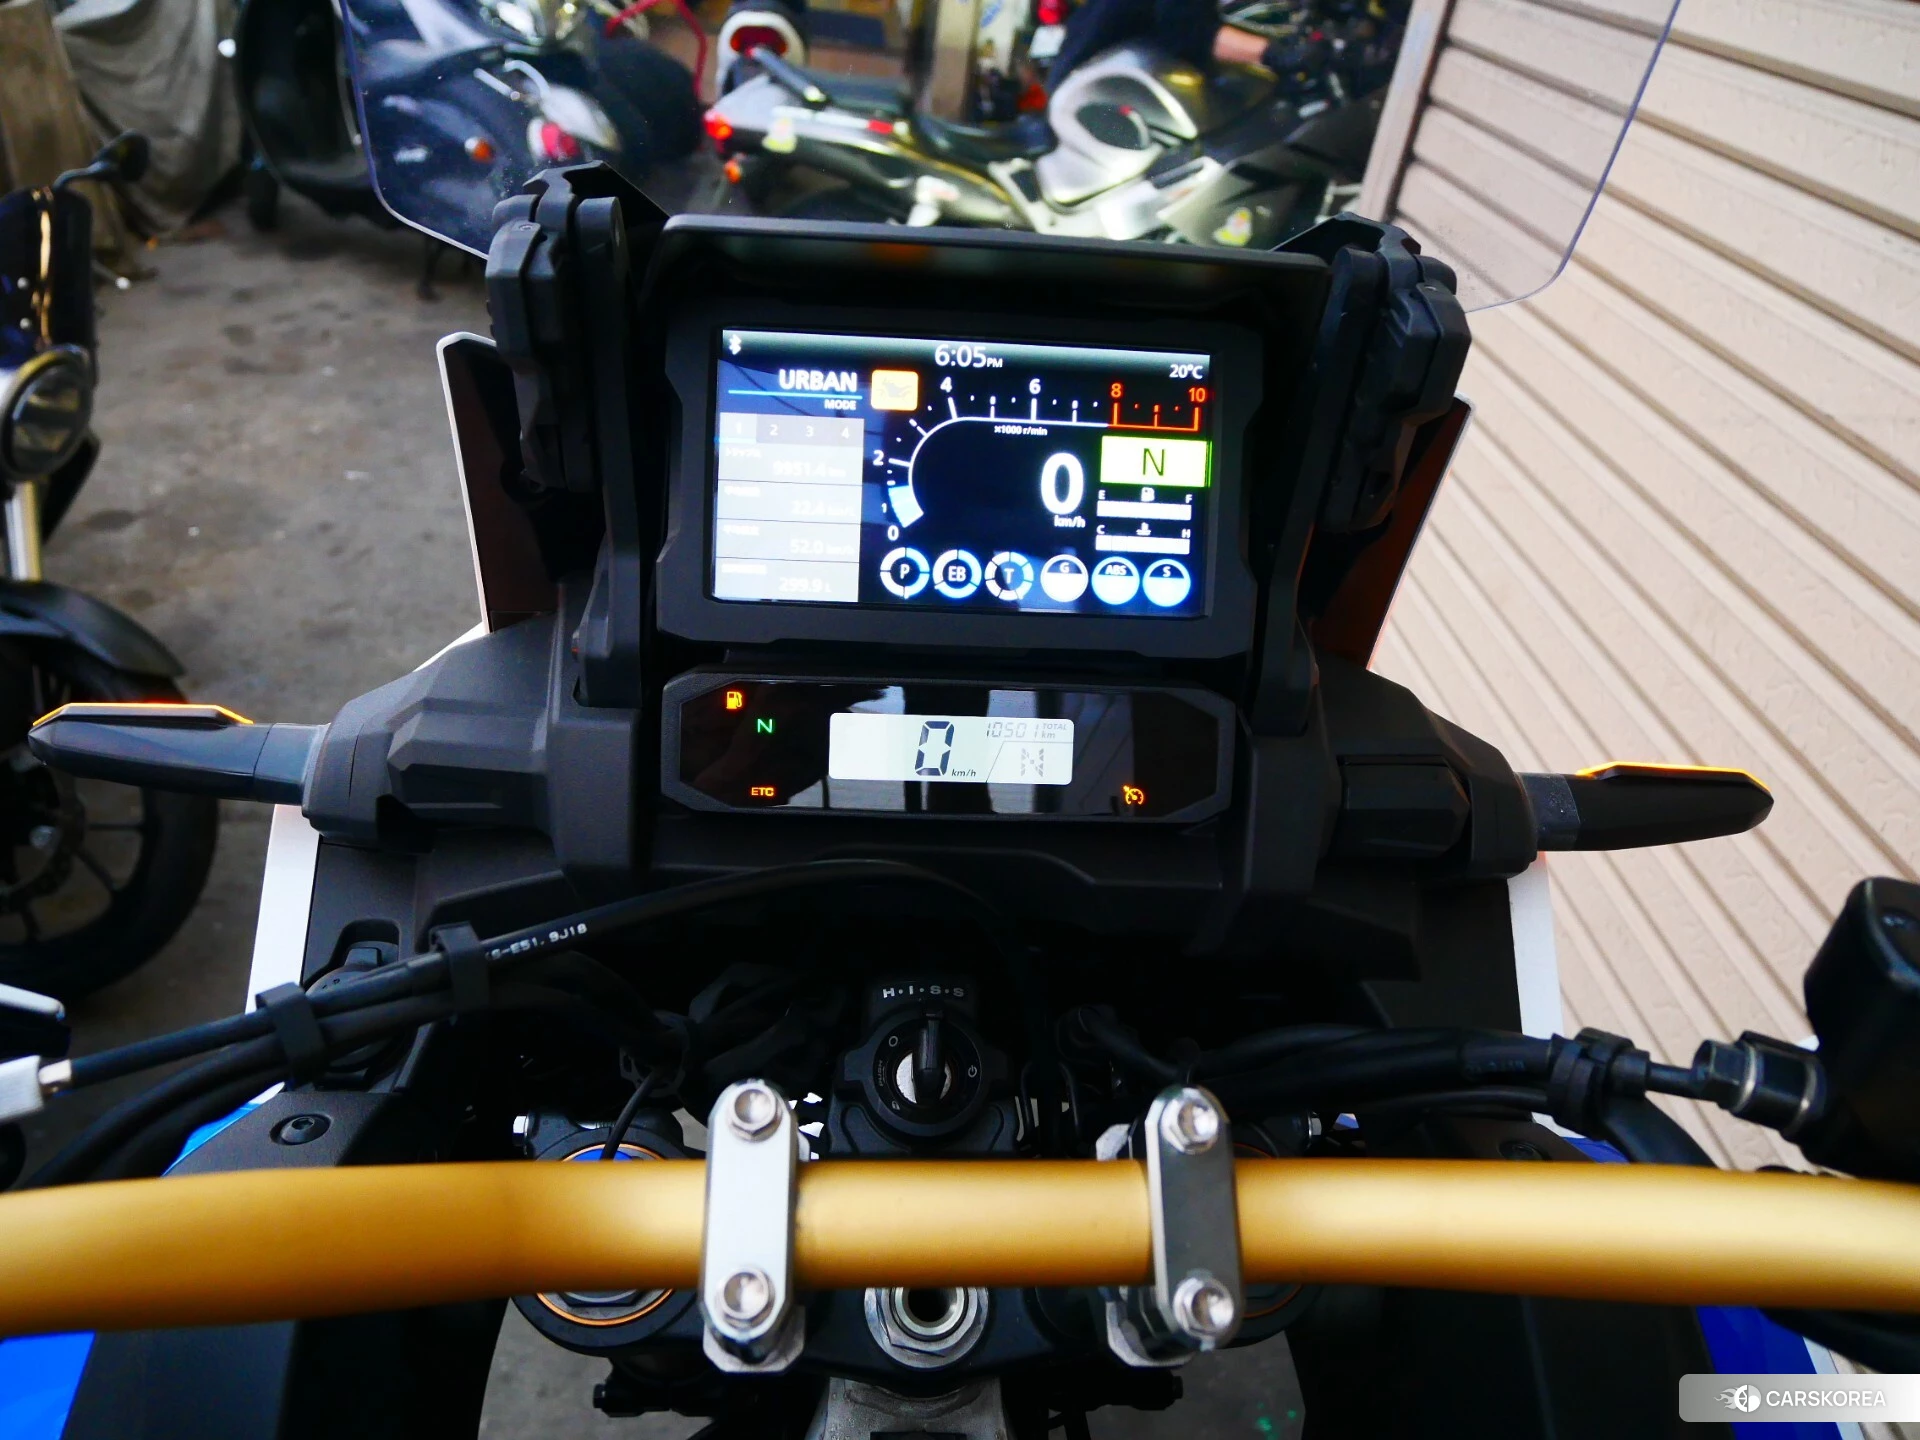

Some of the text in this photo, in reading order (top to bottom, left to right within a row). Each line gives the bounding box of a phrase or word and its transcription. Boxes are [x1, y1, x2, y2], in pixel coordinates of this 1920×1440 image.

[1169, 364, 1204, 379] 20°C
[778, 369, 858, 392] URBAN
[940, 376, 952, 393] 4
[1029, 378, 1041, 394] 6
[1111, 382, 1122, 398] 8
[1188, 387, 1206, 402] 10
[824, 399, 857, 411] MODE
[735, 422, 850, 439] 1 2 3 4
[1022, 426, 1048, 436] r/min
[873, 450, 884, 466] 2
[1142, 447, 1165, 476] N
[1041, 452, 1084, 515] 0
[1098, 489, 1106, 500] E
[1185, 494, 1193, 504] F
[881, 502, 888, 513] 1
[1054, 515, 1086, 528] km/h
[887, 525, 899, 541] 0
[1096, 525, 1105, 535] C
[1181, 529, 1191, 538] H
[899, 562, 1171, 584] P EB T G ABS S
[757, 718, 773, 733] N
[1042, 723, 1067, 731] TOTAL
[1042, 731, 1056, 739] km
[915, 720, 955, 776] 0
[1020, 748, 1045, 777] N
[951, 769, 977, 777] km/h
[751, 786, 775, 797] ETC
